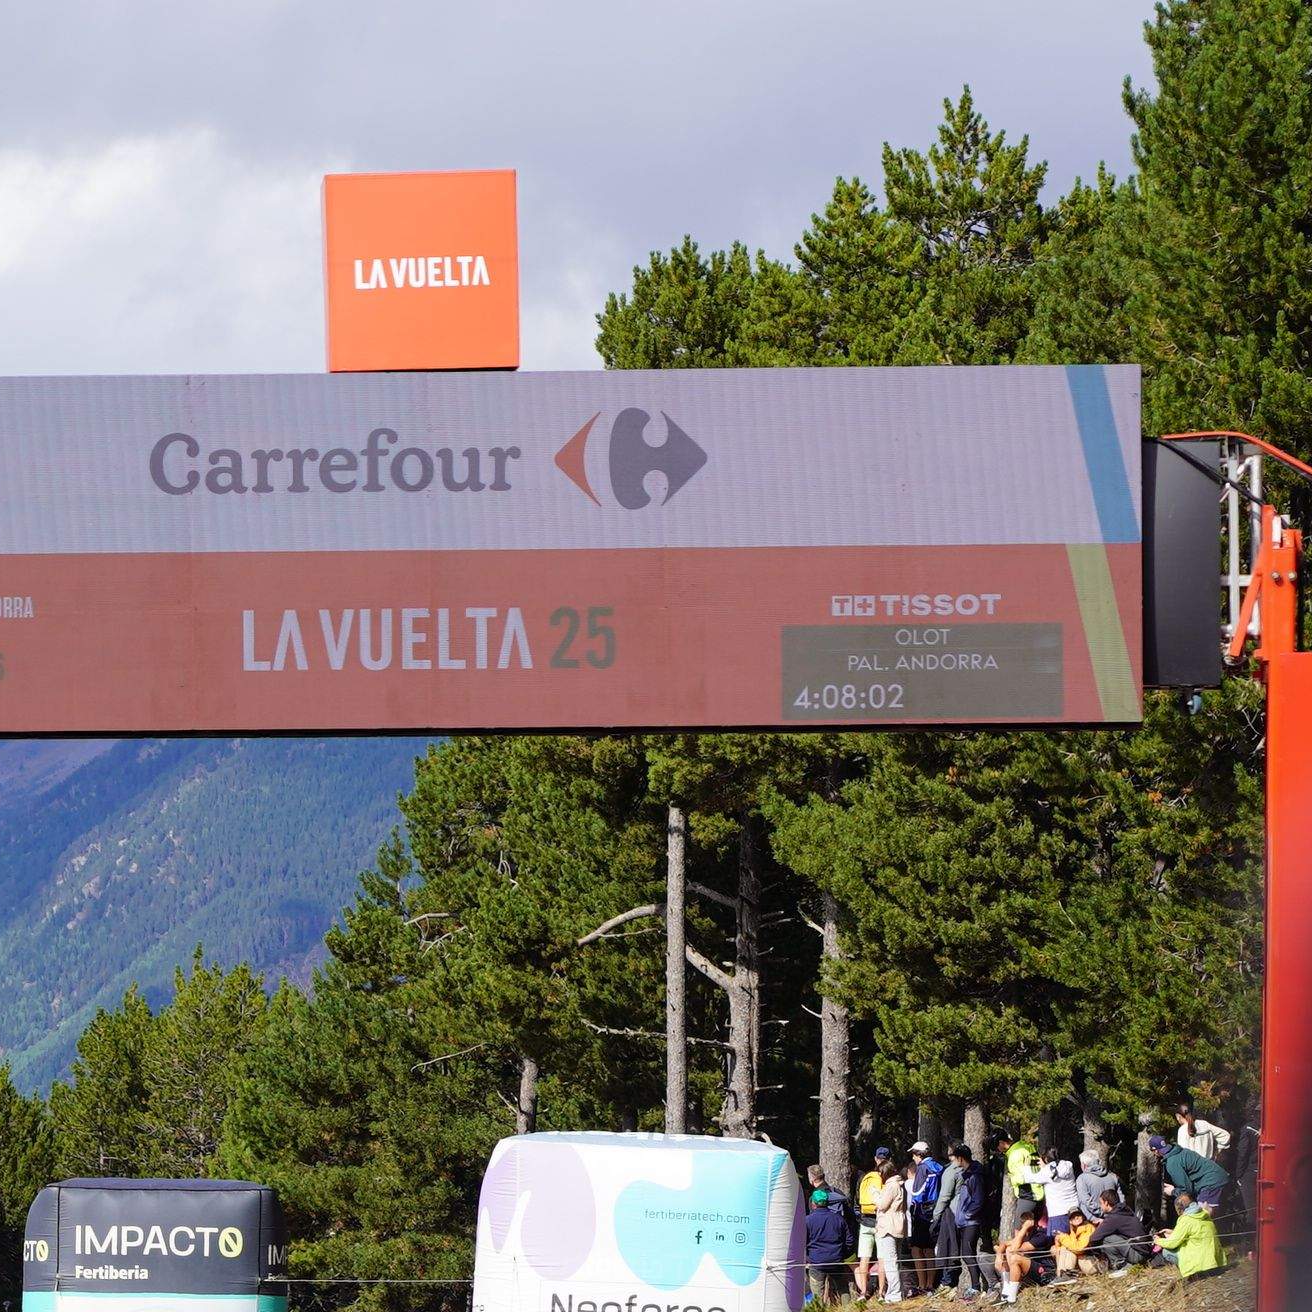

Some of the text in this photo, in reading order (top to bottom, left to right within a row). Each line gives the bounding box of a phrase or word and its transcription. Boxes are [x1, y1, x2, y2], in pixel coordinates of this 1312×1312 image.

[355, 255, 489, 289] LA VUELTA
[149, 427, 521, 494] Carrefour
[880, 593, 1002, 616] TISSOT
[242, 606, 617, 671] LA VUELTA 25
[895, 628, 951, 645] OLOT
[848, 654, 999, 671] PAL. ANDORRA
[793, 684, 904, 709] 4:08:02
[644, 1208, 750, 1224] fertiberiatech.com
[75, 1265, 149, 1280] Fertiberia
